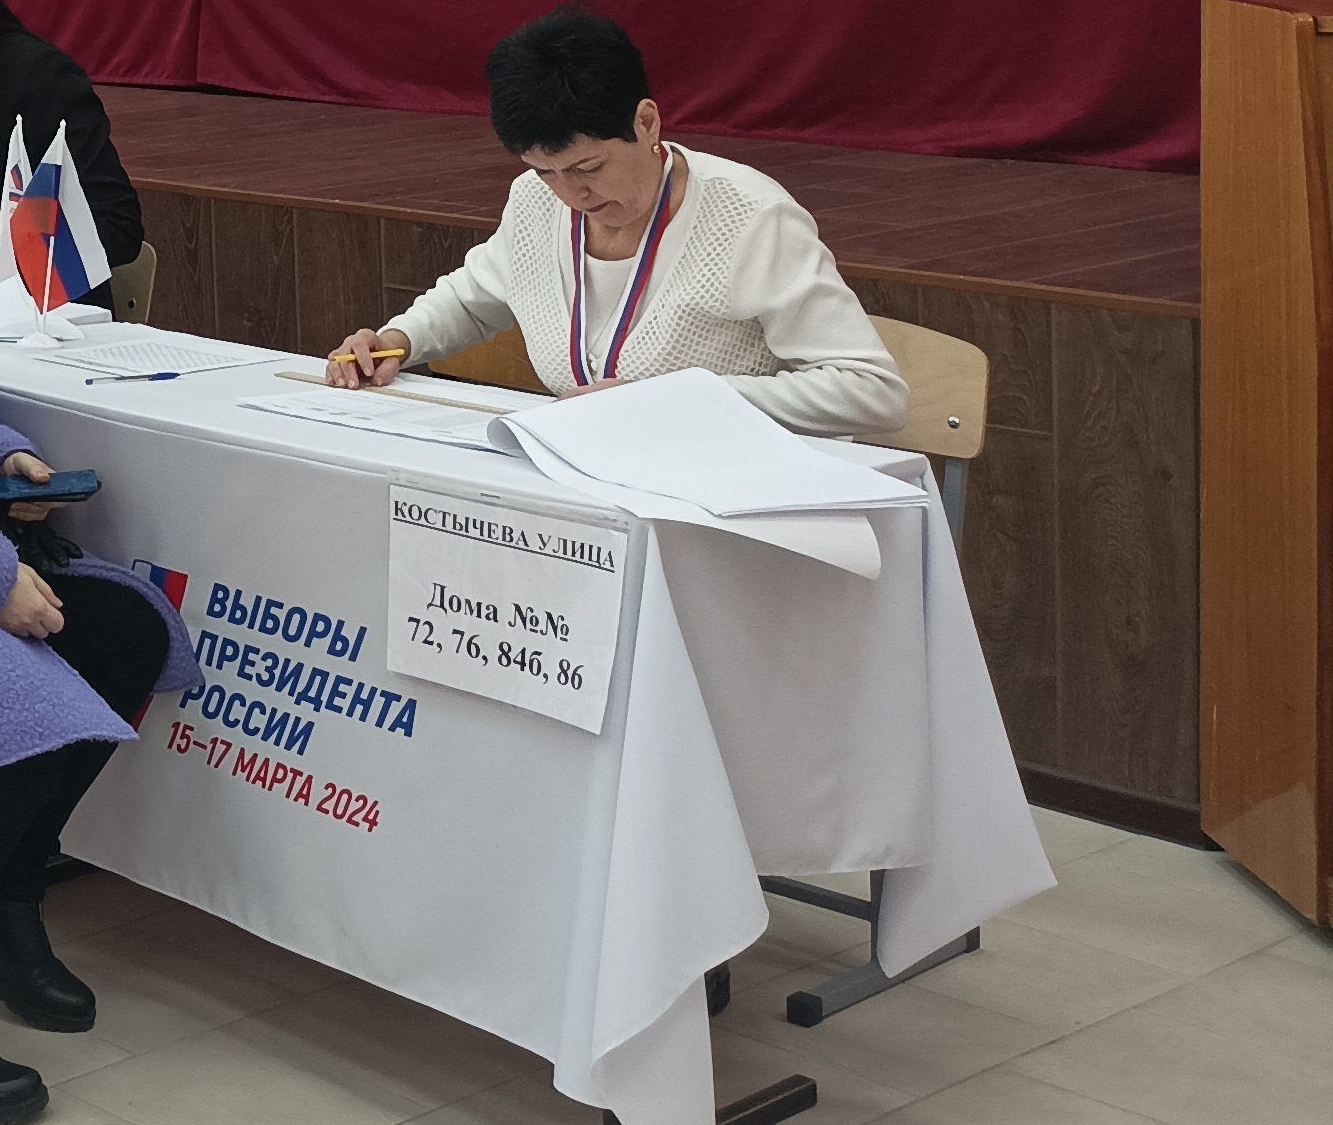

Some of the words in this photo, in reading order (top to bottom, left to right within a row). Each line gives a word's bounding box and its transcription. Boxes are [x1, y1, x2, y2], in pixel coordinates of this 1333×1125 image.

[393, 500, 531, 549] КОСТЫЧЕВА
[536, 532, 615, 569] УЛИЦА
[205, 582, 368, 663] ВЫБОРЫ
[426, 582, 499, 624] Дома
[507, 602, 571, 643] №№
[195, 629, 418, 739] ПРЕЗИДЕНТА
[407, 616, 443, 654] 72,
[451, 628, 489, 667] 76,
[556, 658, 585, 691] 86
[179, 681, 316, 757] РОССИИ
[231, 746, 314, 808] МАРТА
[315, 783, 381, 834] 2024
